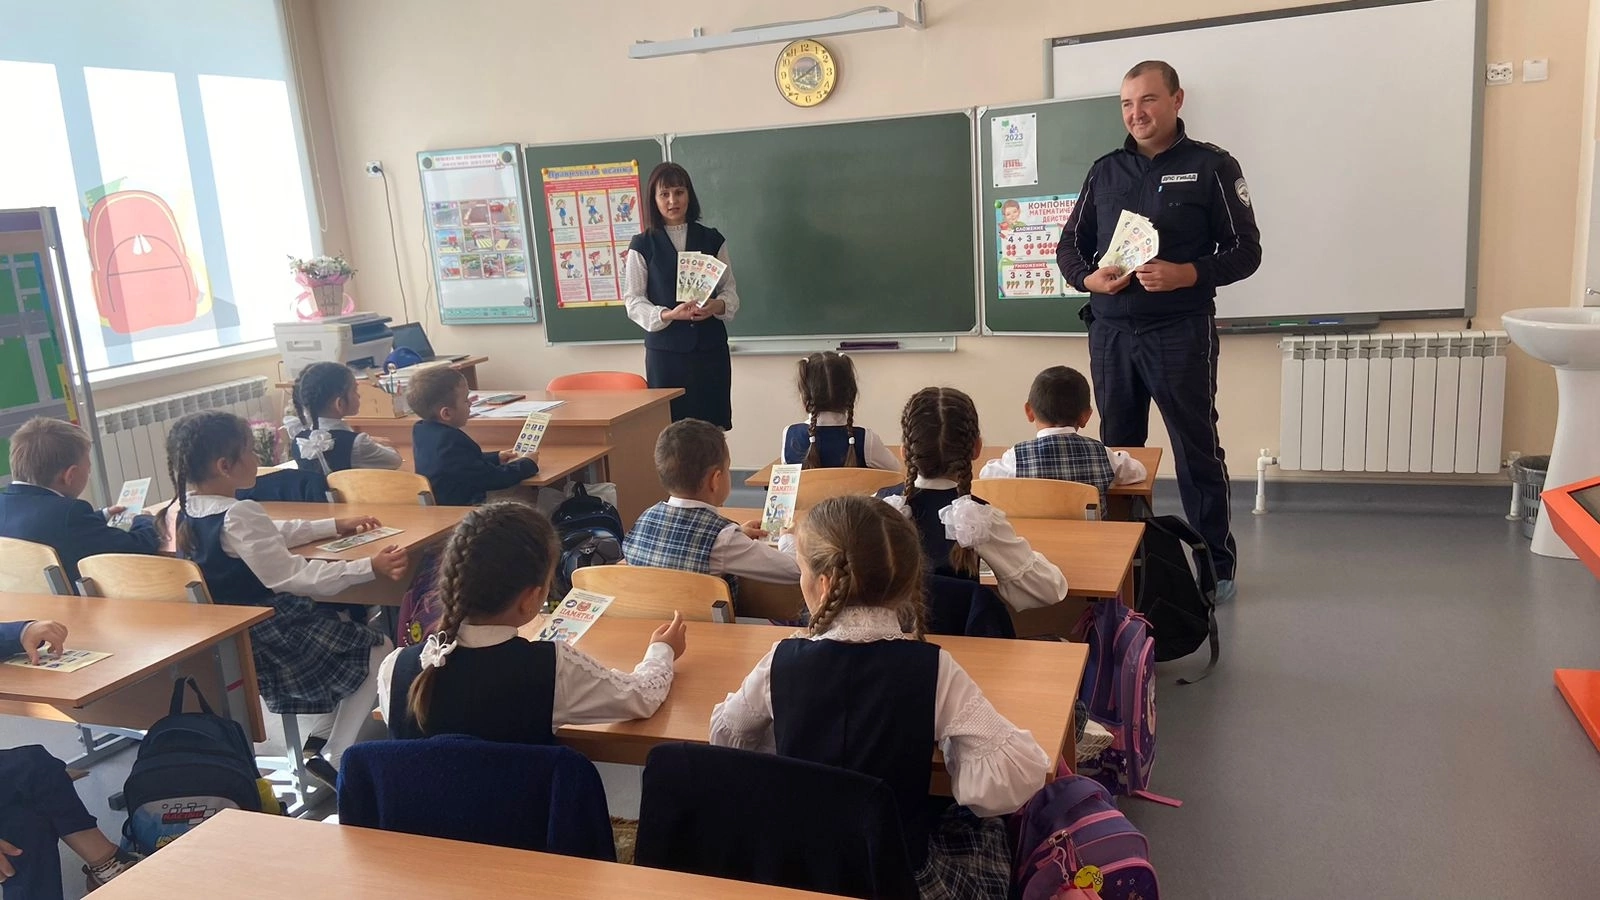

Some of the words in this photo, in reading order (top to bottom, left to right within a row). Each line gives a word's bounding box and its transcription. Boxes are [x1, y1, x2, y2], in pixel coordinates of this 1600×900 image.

[790, 48, 797, 56] 11
[800, 43, 809, 52] 12
[822, 55, 828, 63] 2
[826, 67, 832, 76] 3
[793, 92, 799, 101] 7
[805, 95, 811, 103] 6
[1005, 133, 1024, 142] 2023
[1045, 270, 1051, 278] 6
[560, 608, 595, 620] ПАМЯТКА
